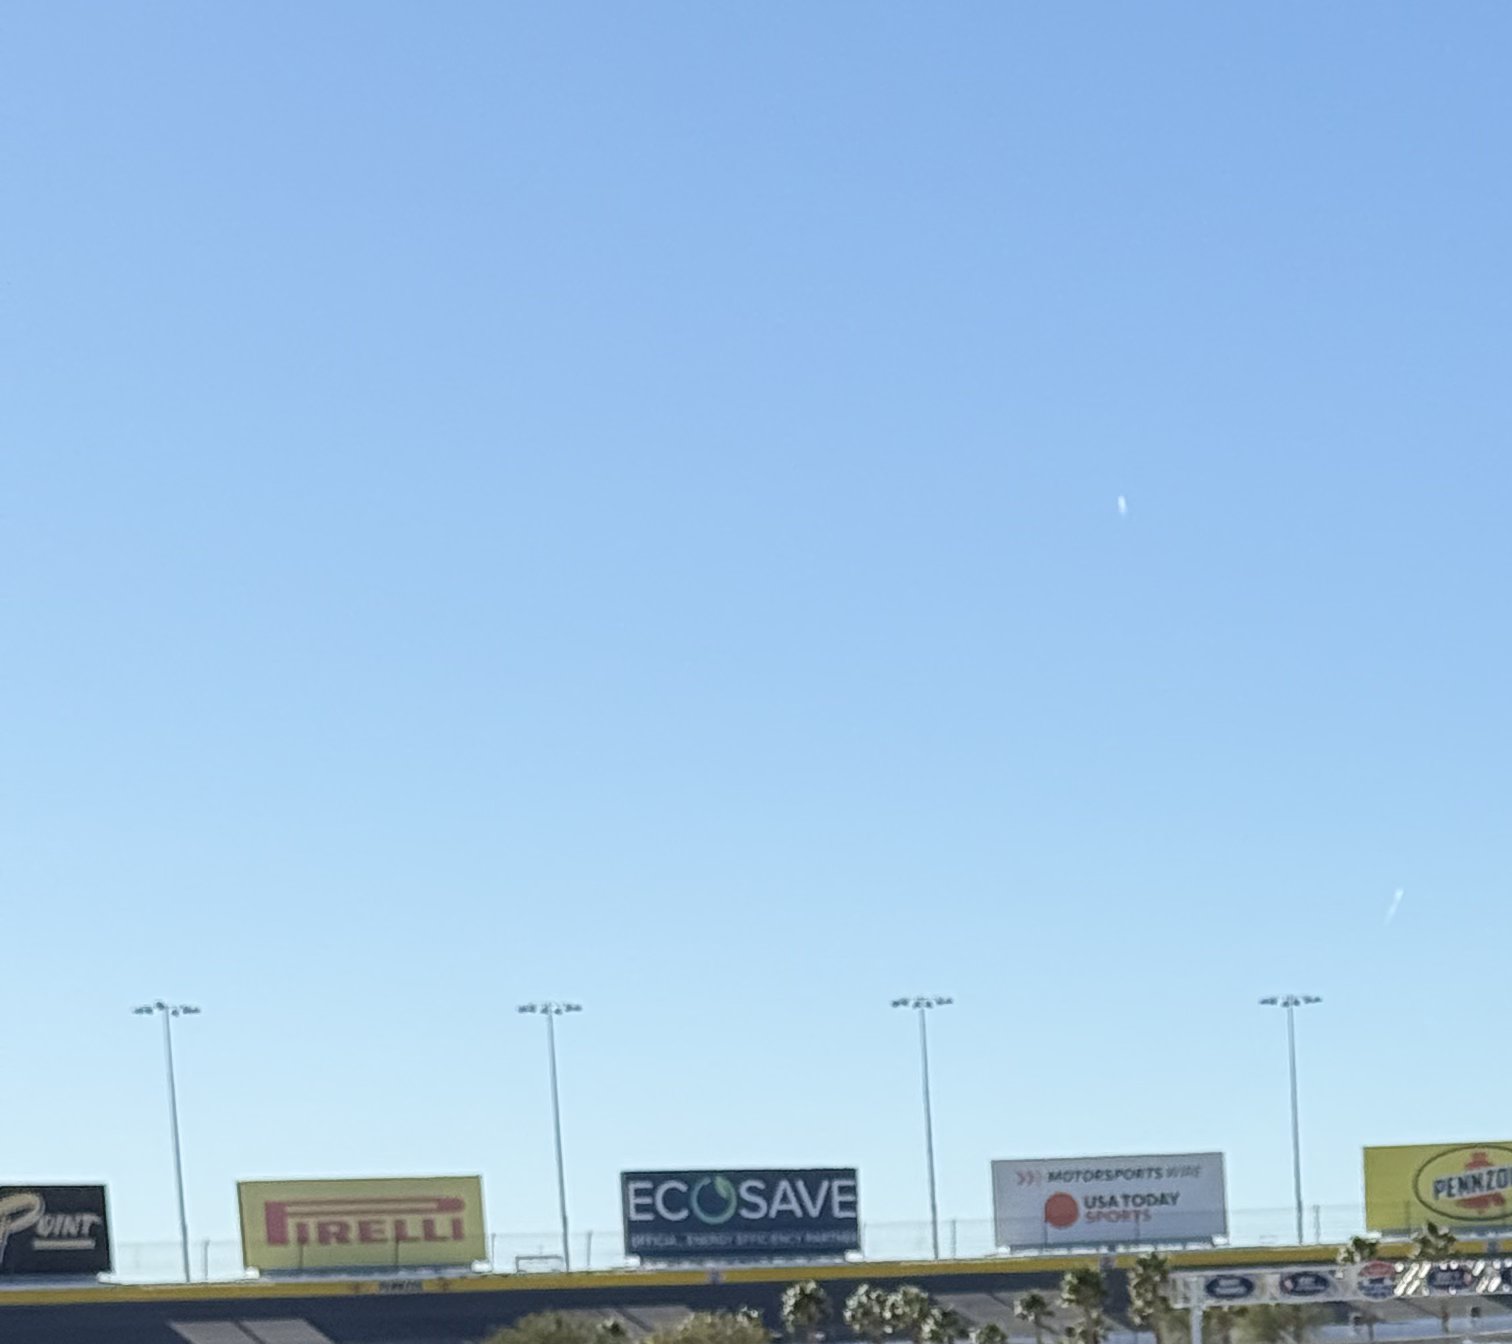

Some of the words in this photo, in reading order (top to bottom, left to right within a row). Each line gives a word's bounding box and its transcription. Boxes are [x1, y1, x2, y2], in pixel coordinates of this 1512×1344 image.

[1048, 1167, 1163, 1184] MOTORSPORTS
[1166, 1165, 1202, 1180] WIRE
[627, 1175, 857, 1225] ECOSAVE
[1084, 1195, 1121, 1210] USA
[1122, 1192, 1181, 1208] TODAY
[264, 1197, 465, 1246] PIRELLI
[1086, 1209, 1152, 1224] SPORTS
